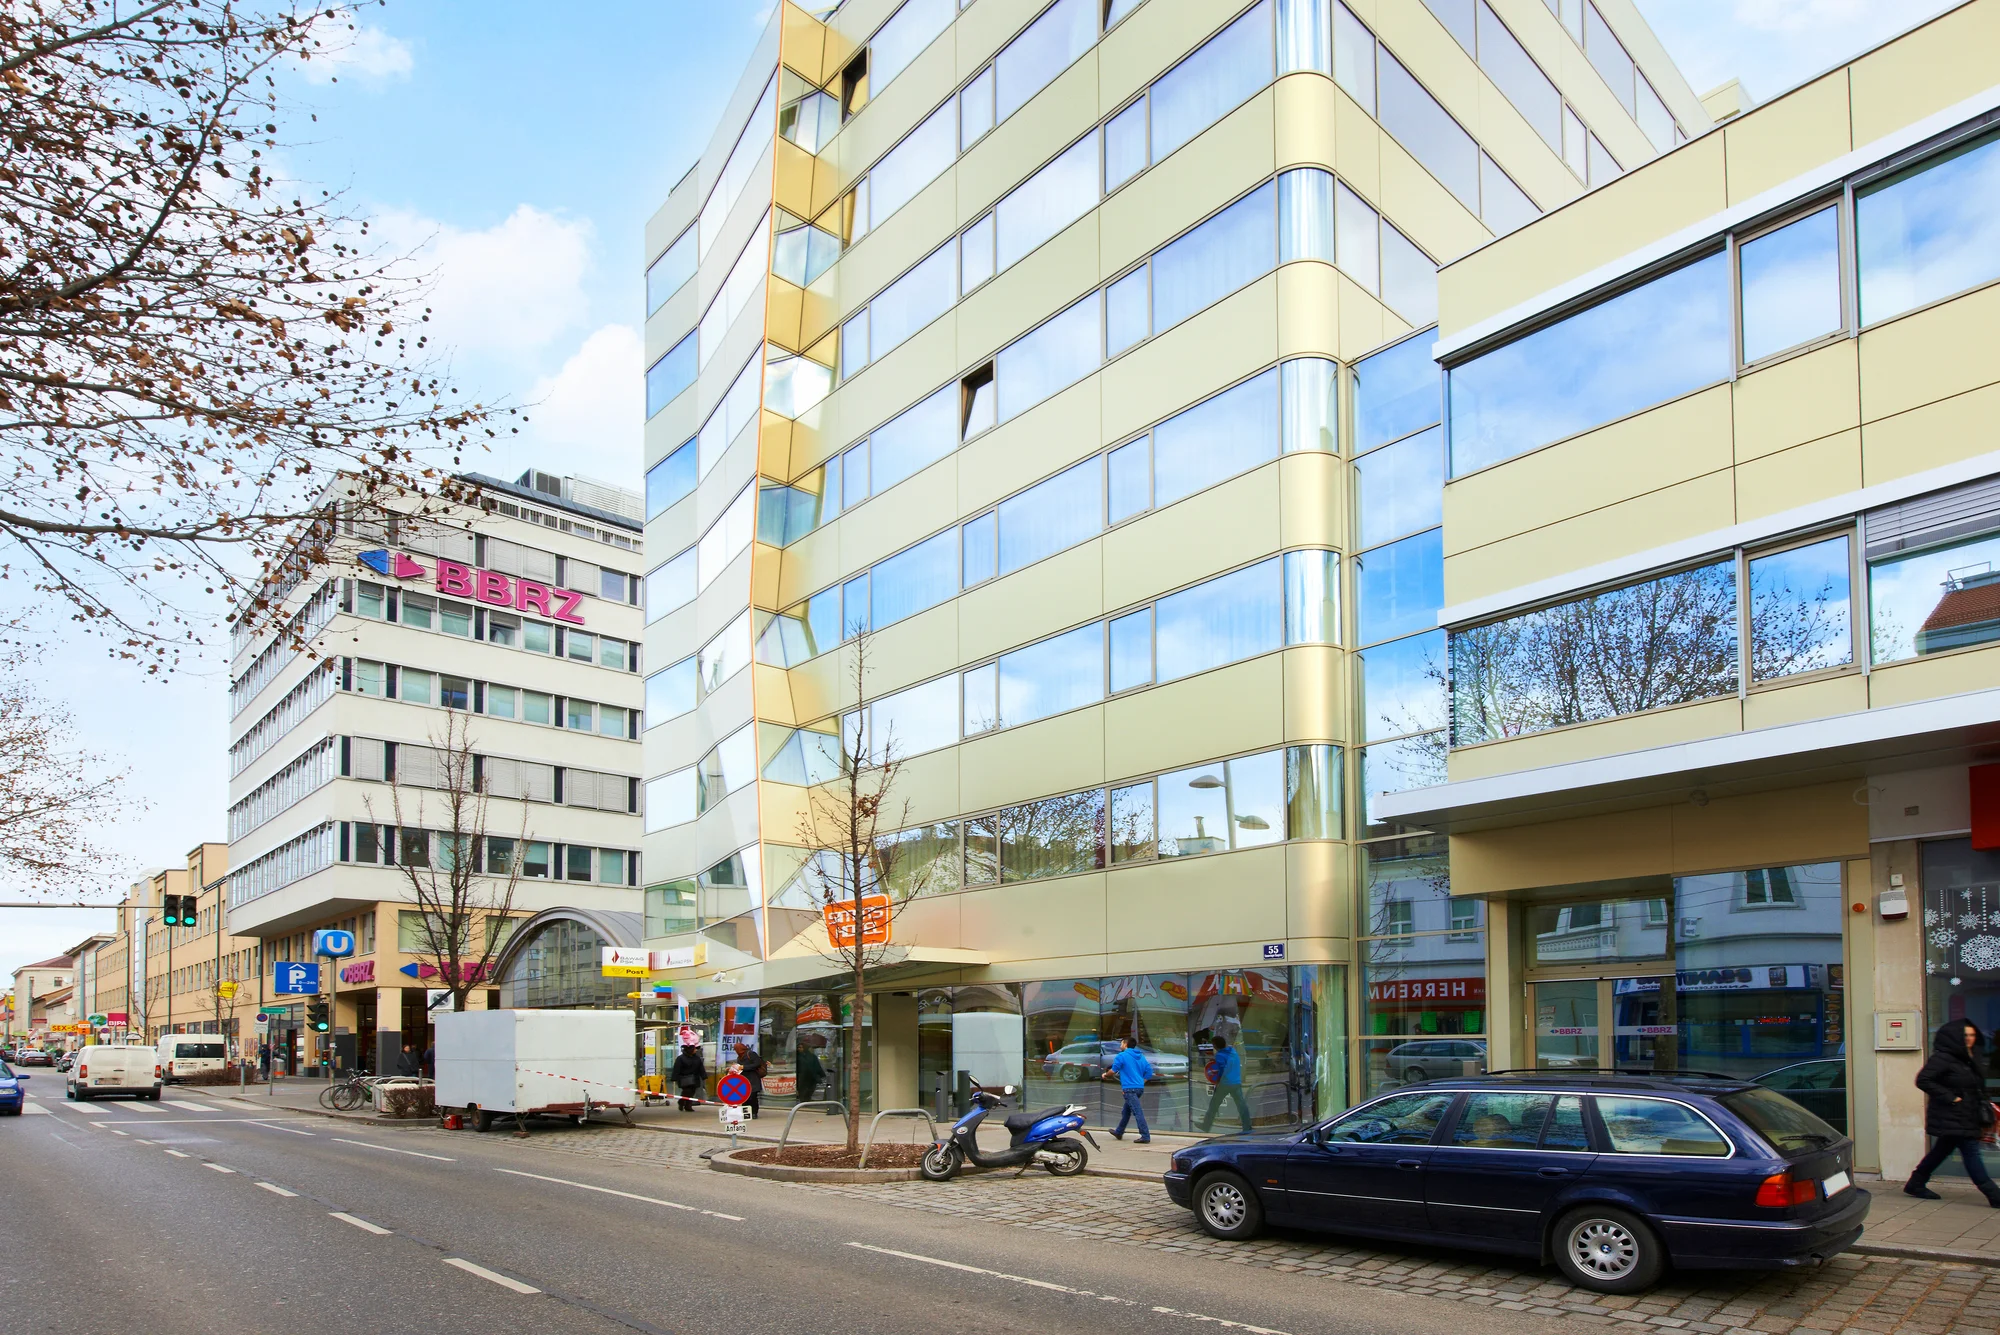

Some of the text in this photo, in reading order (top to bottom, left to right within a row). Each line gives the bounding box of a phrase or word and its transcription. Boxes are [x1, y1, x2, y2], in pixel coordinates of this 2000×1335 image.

[436, 558, 585, 625] BBRZ
[835, 921, 884, 938] HOEL
[327, 935, 349, 953] U
[1268, 945, 1279, 955] 55
[289, 969, 307, 984] P
[1647, 1026, 1673, 1034] BBRZ
